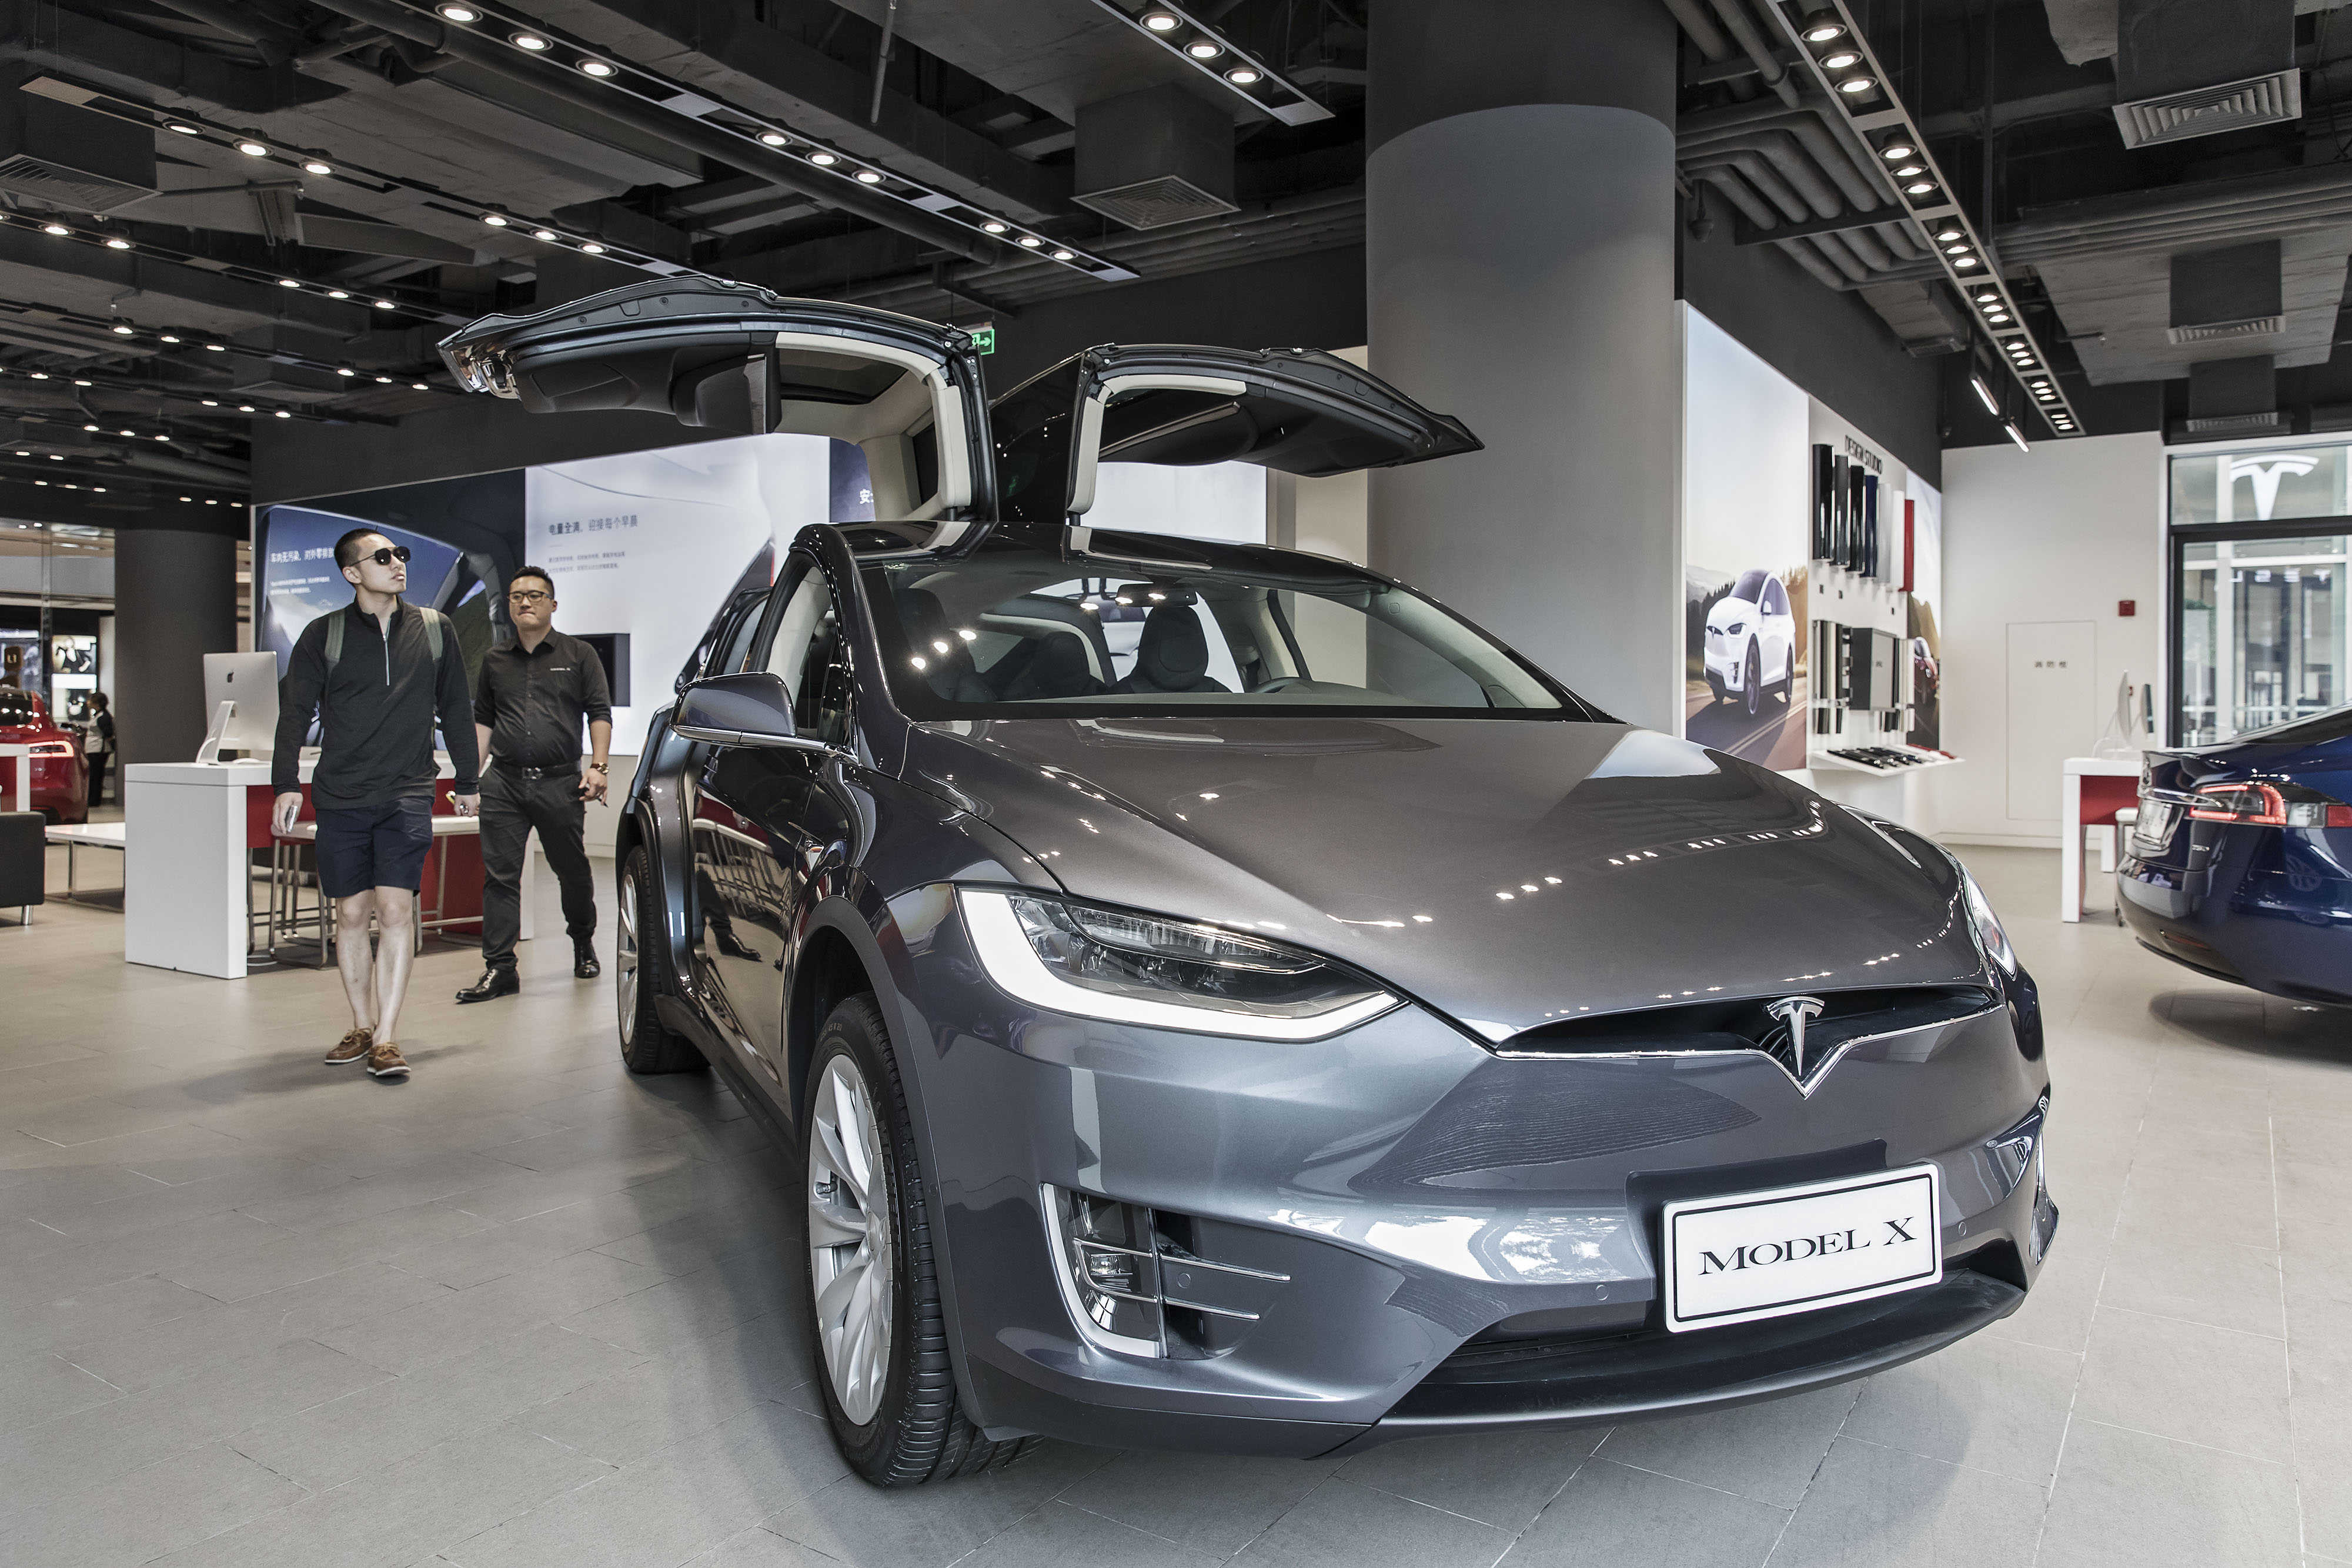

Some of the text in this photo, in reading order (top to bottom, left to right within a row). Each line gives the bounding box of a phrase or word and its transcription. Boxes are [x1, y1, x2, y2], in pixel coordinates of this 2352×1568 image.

[1865, 450, 1883, 474] STUDIO
[860, 489, 874, 504] 安
[1698, 1216, 1917, 1276] MODEL X
